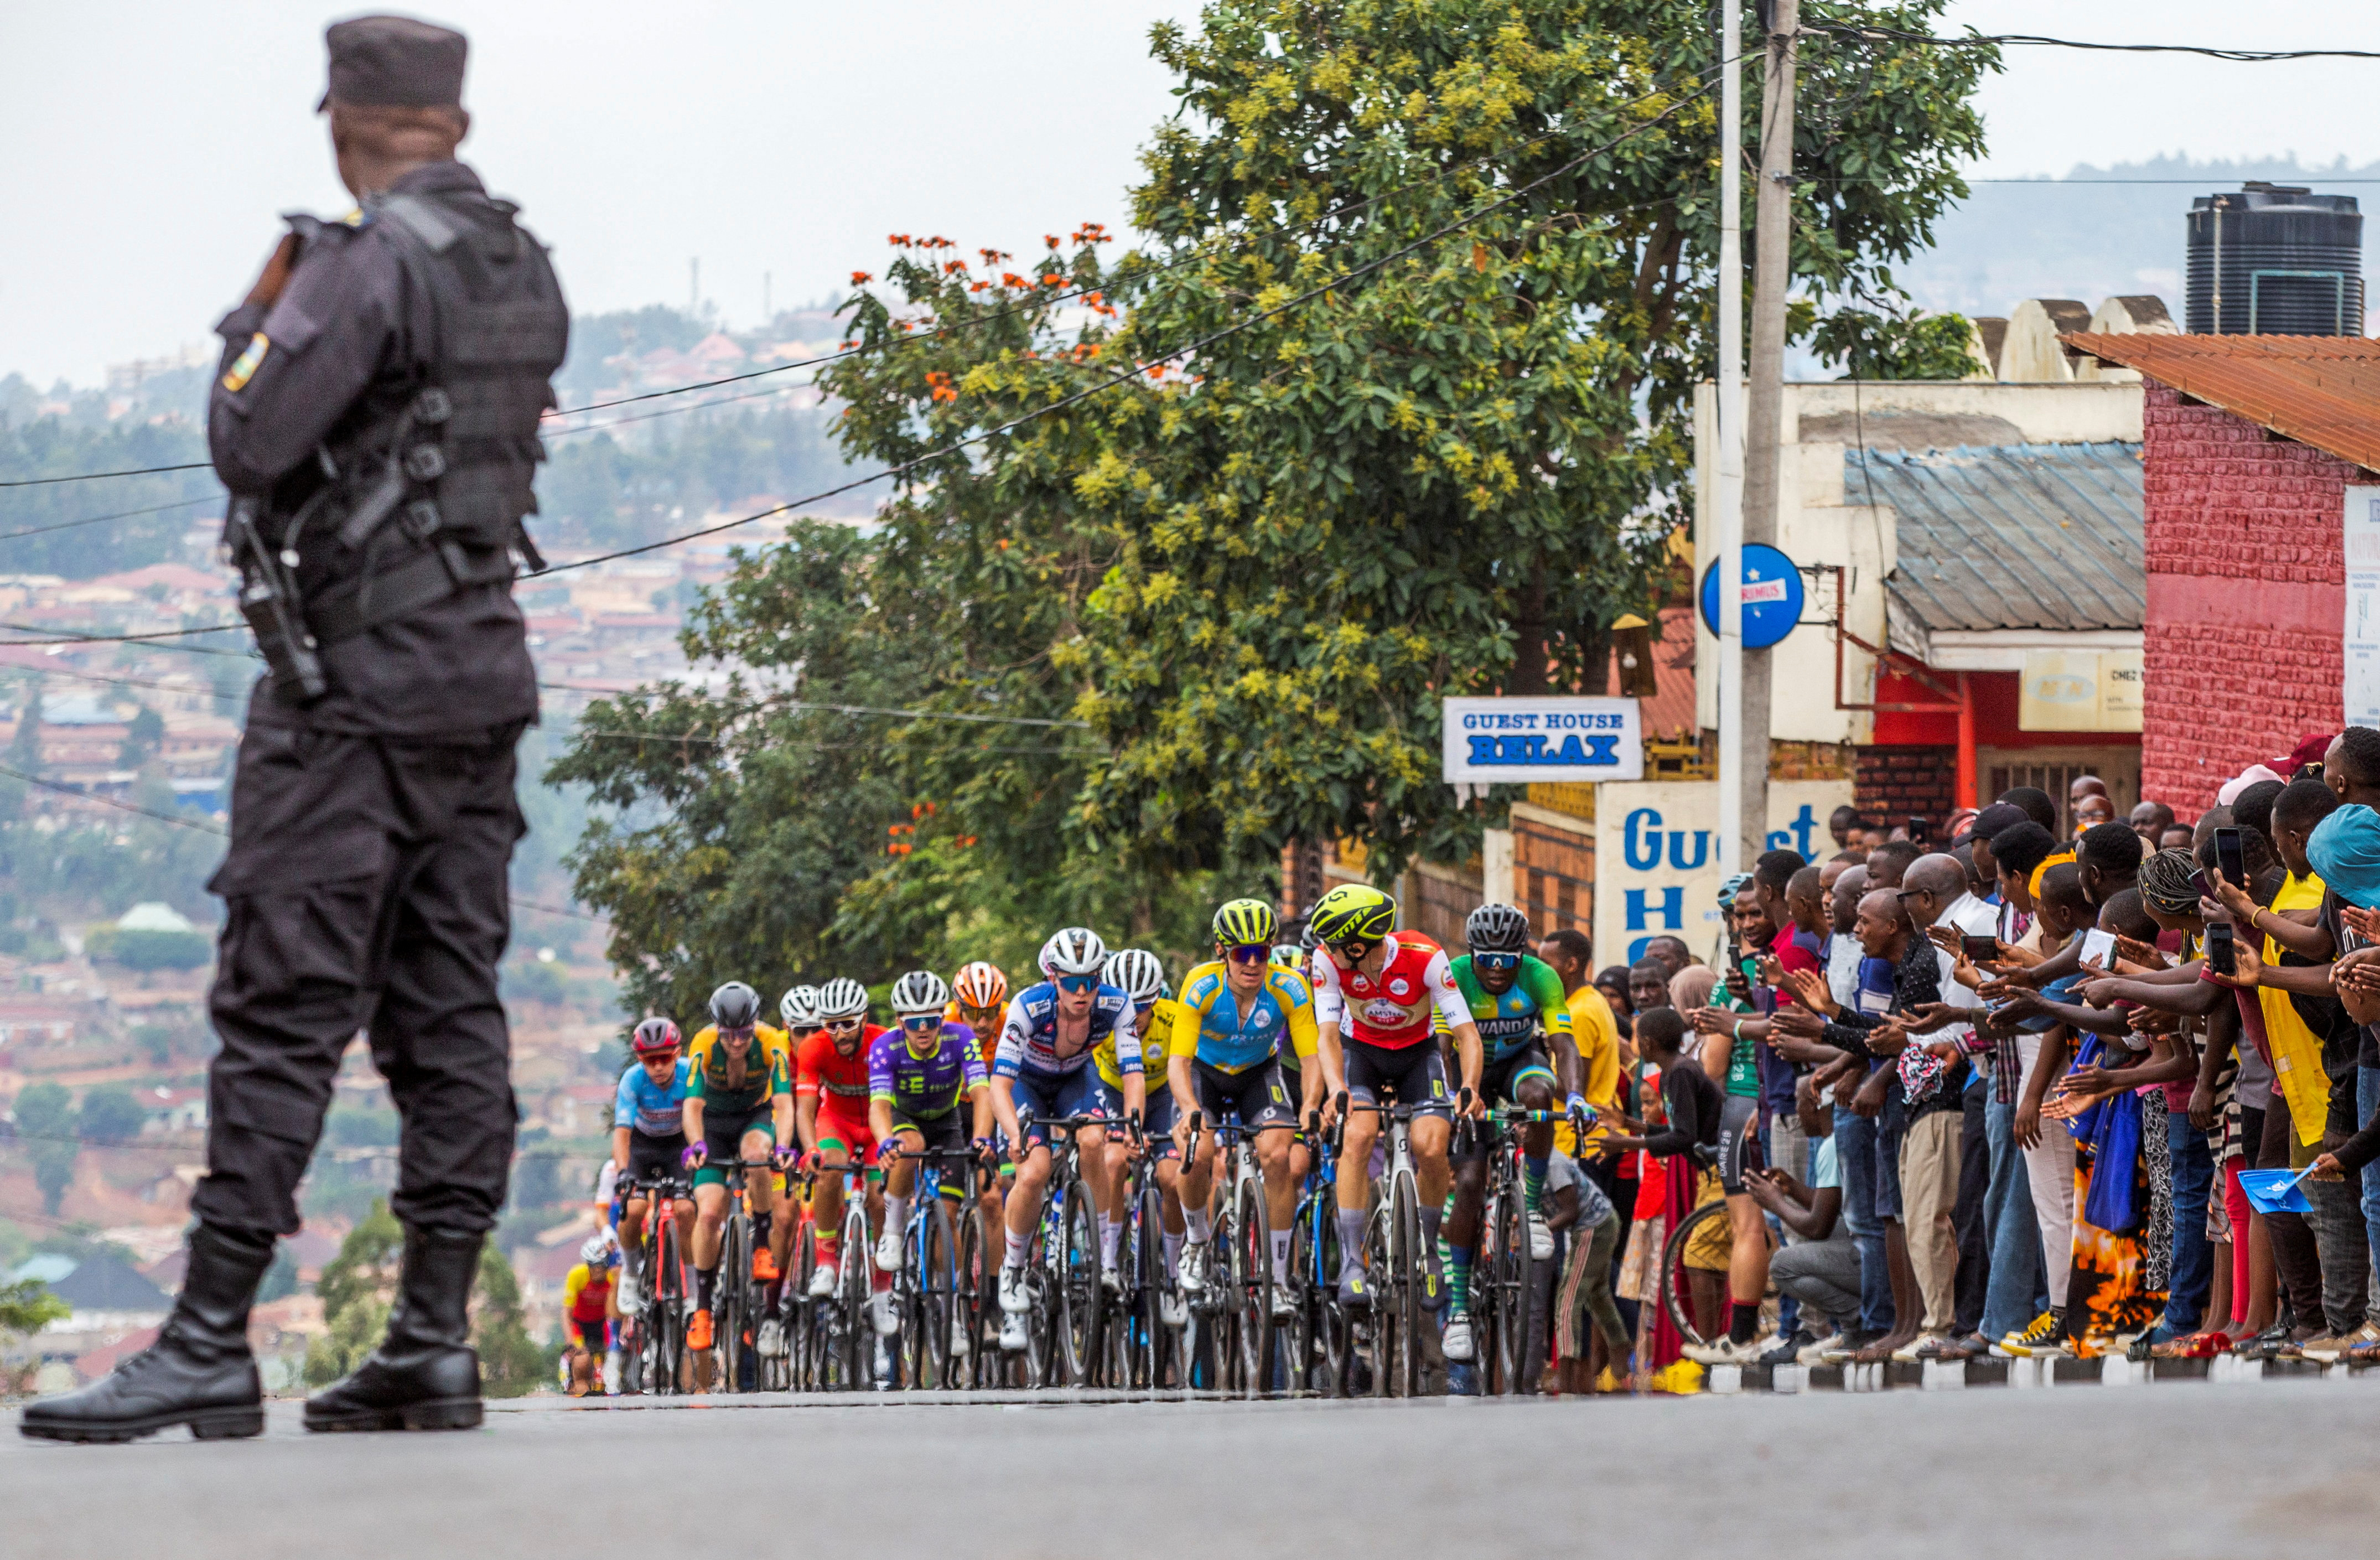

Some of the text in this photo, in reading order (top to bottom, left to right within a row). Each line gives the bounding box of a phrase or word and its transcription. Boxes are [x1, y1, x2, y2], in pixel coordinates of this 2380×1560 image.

[1741, 585, 1779, 600] RIMUS
[2039, 681, 2084, 697] MTN
[1463, 714, 1624, 729] GUEST HOUSE
[1467, 735, 1619, 765] RELAX
[1624, 805, 1821, 870] Gut
[1709, 979, 1725, 1004] ARE
[1477, 1017, 1531, 1035] WANDA
